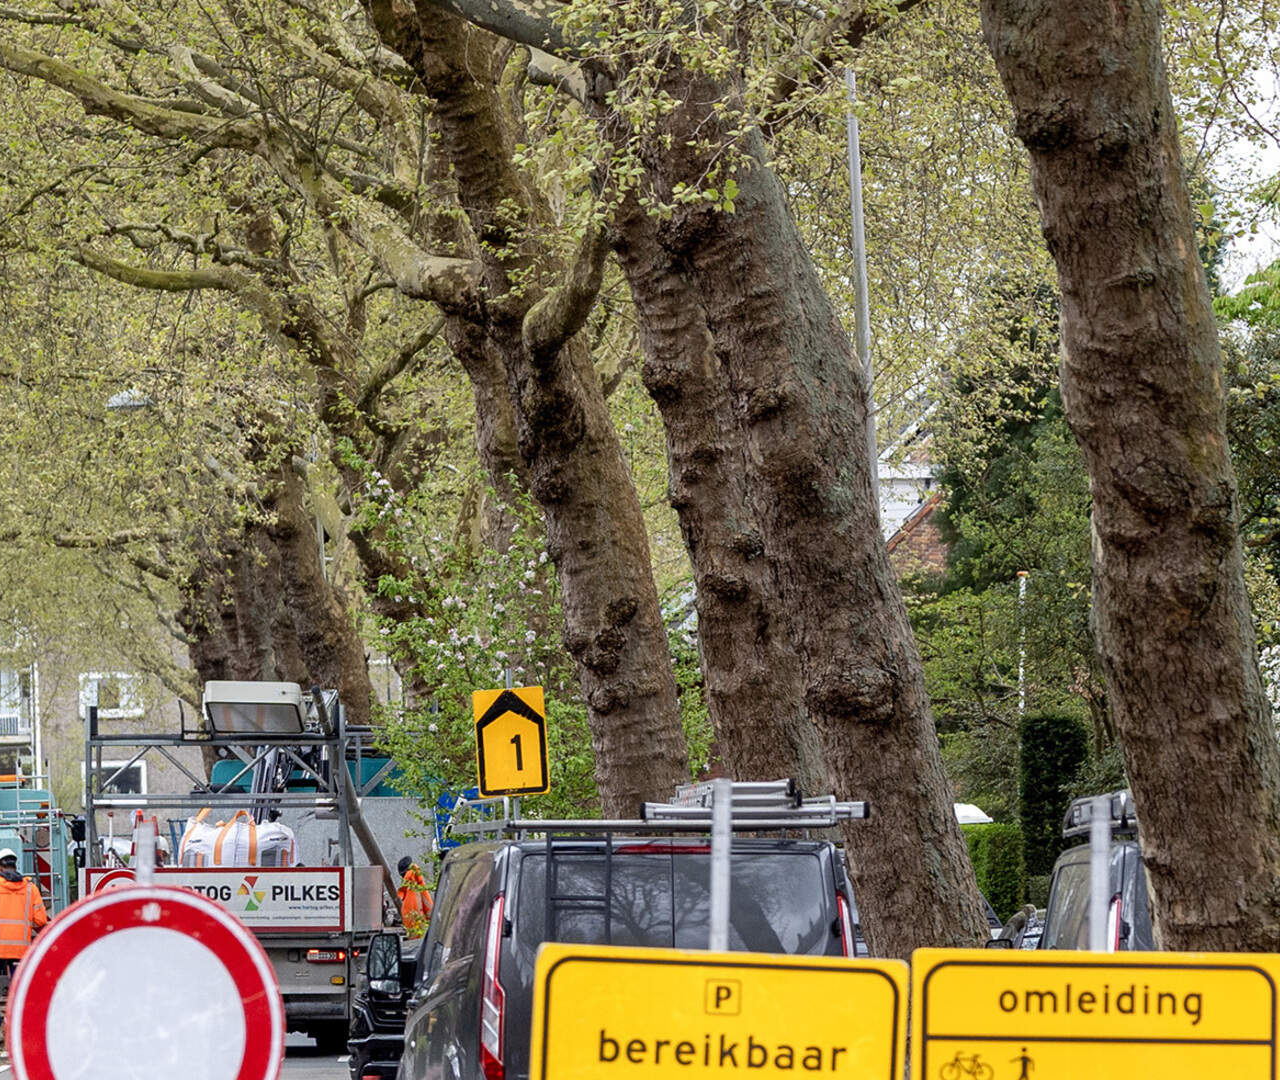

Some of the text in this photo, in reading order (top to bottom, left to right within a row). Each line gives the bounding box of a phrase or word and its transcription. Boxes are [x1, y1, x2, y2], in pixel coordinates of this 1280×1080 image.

[510, 734, 523, 771] 1
[271, 885, 340, 901] PILKES
[715, 986, 731, 1009] P
[999, 984, 1202, 1025] omleiding
[599, 1030, 847, 1071] bereikbaar
